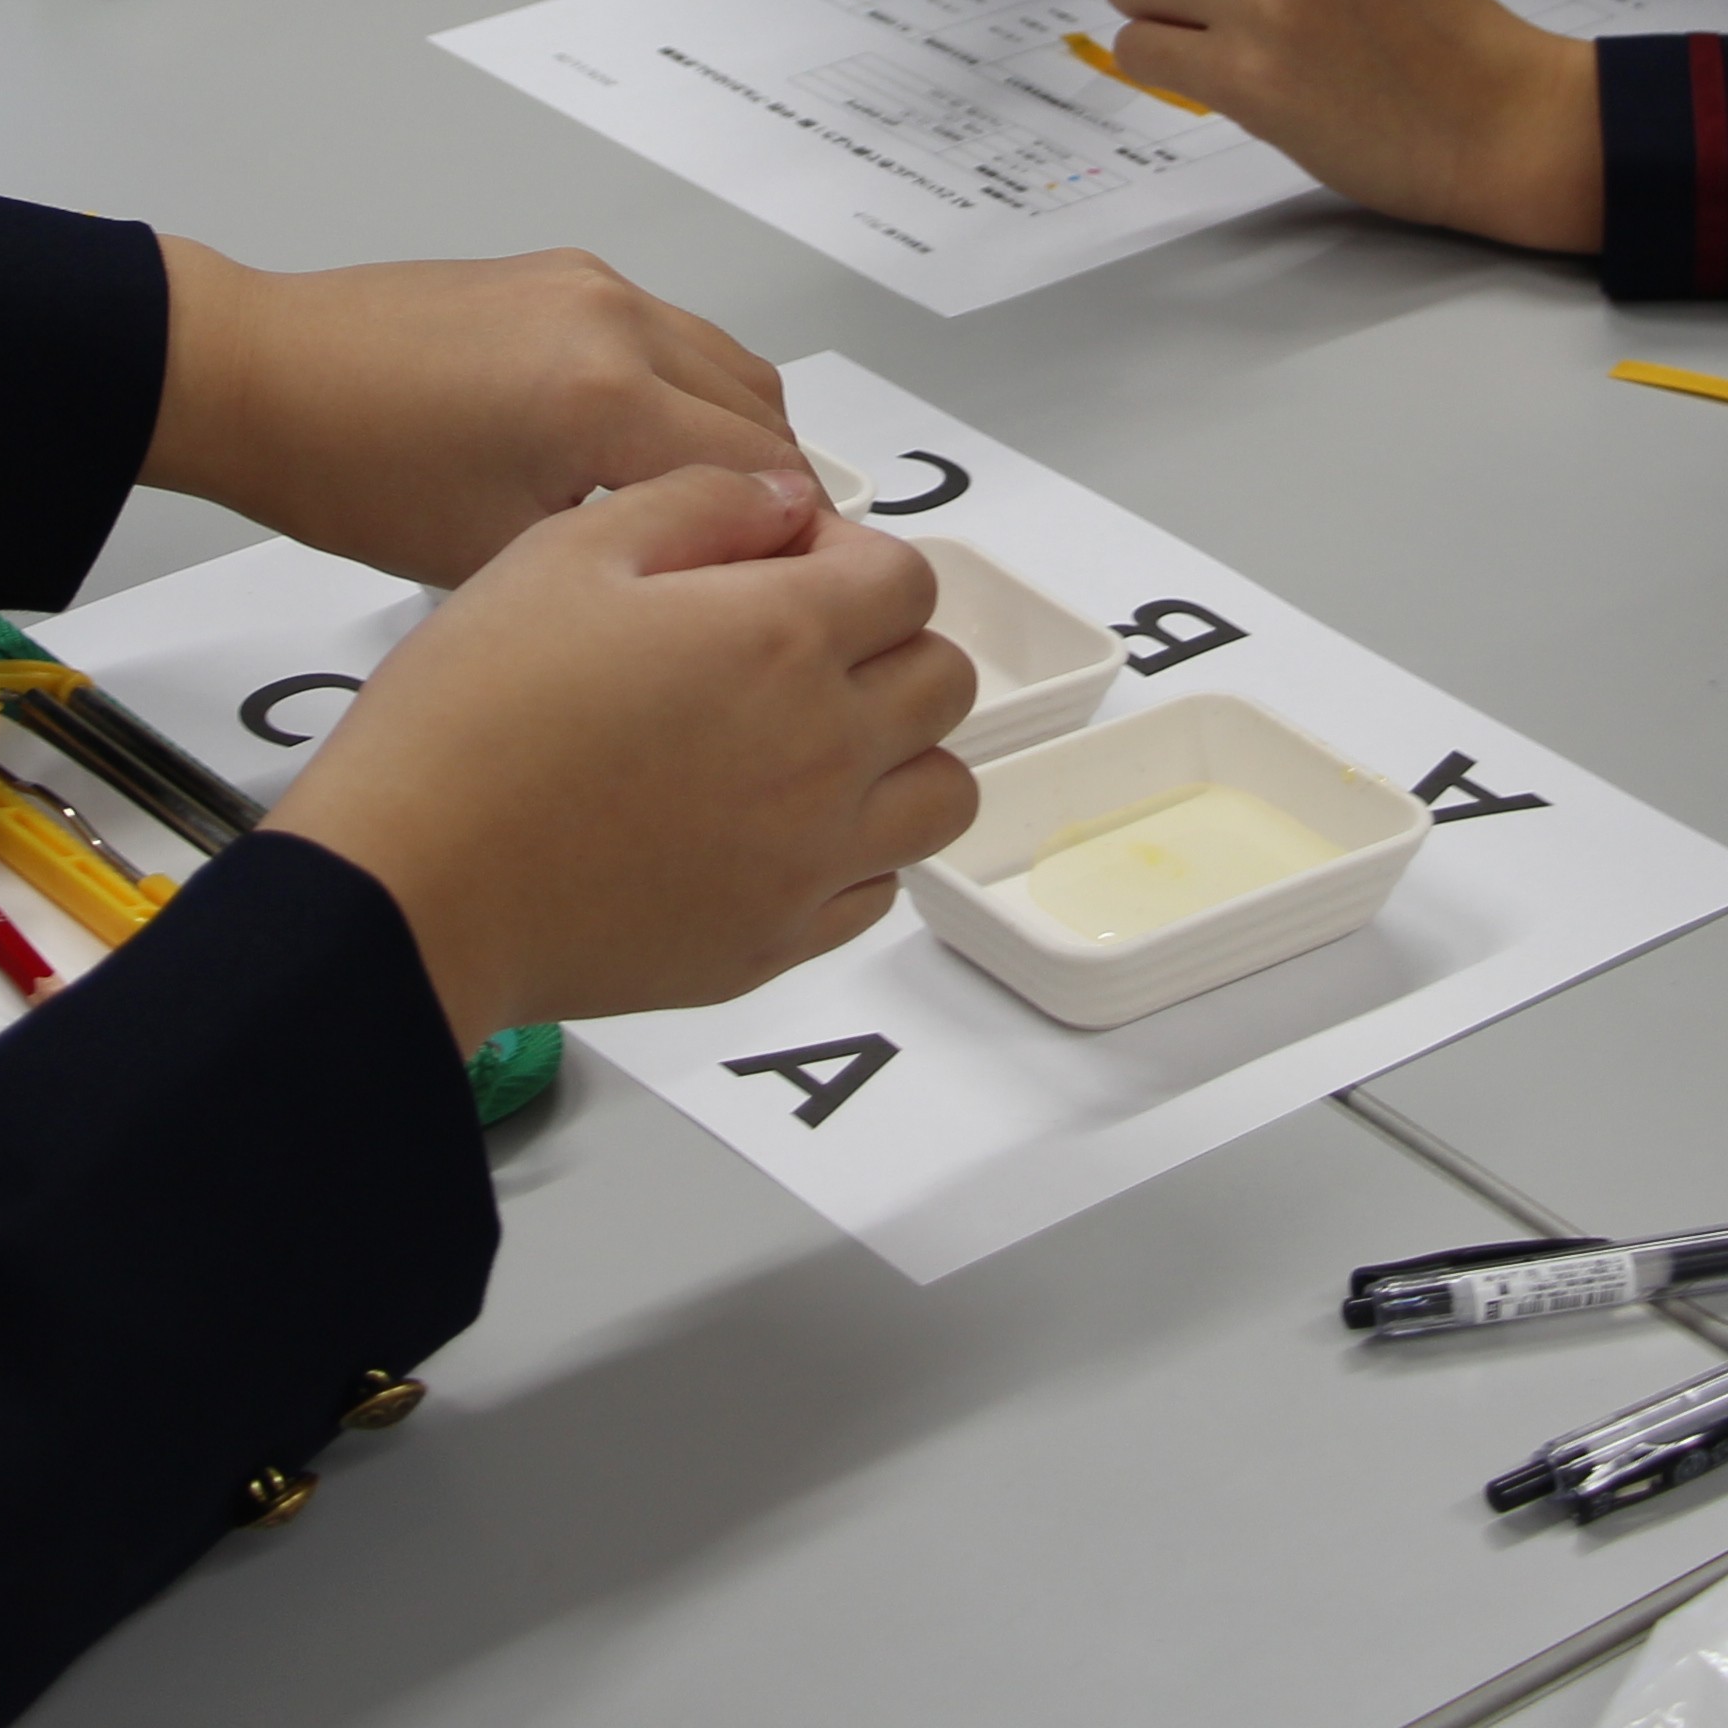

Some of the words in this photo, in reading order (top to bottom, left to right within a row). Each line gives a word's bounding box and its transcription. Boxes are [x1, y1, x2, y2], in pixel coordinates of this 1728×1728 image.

[869, 449, 972, 515] C
[1106, 598, 1251, 678] B
[238, 672, 365, 748] C
[1409, 749, 1554, 826] A
[718, 1032, 902, 1129] A
